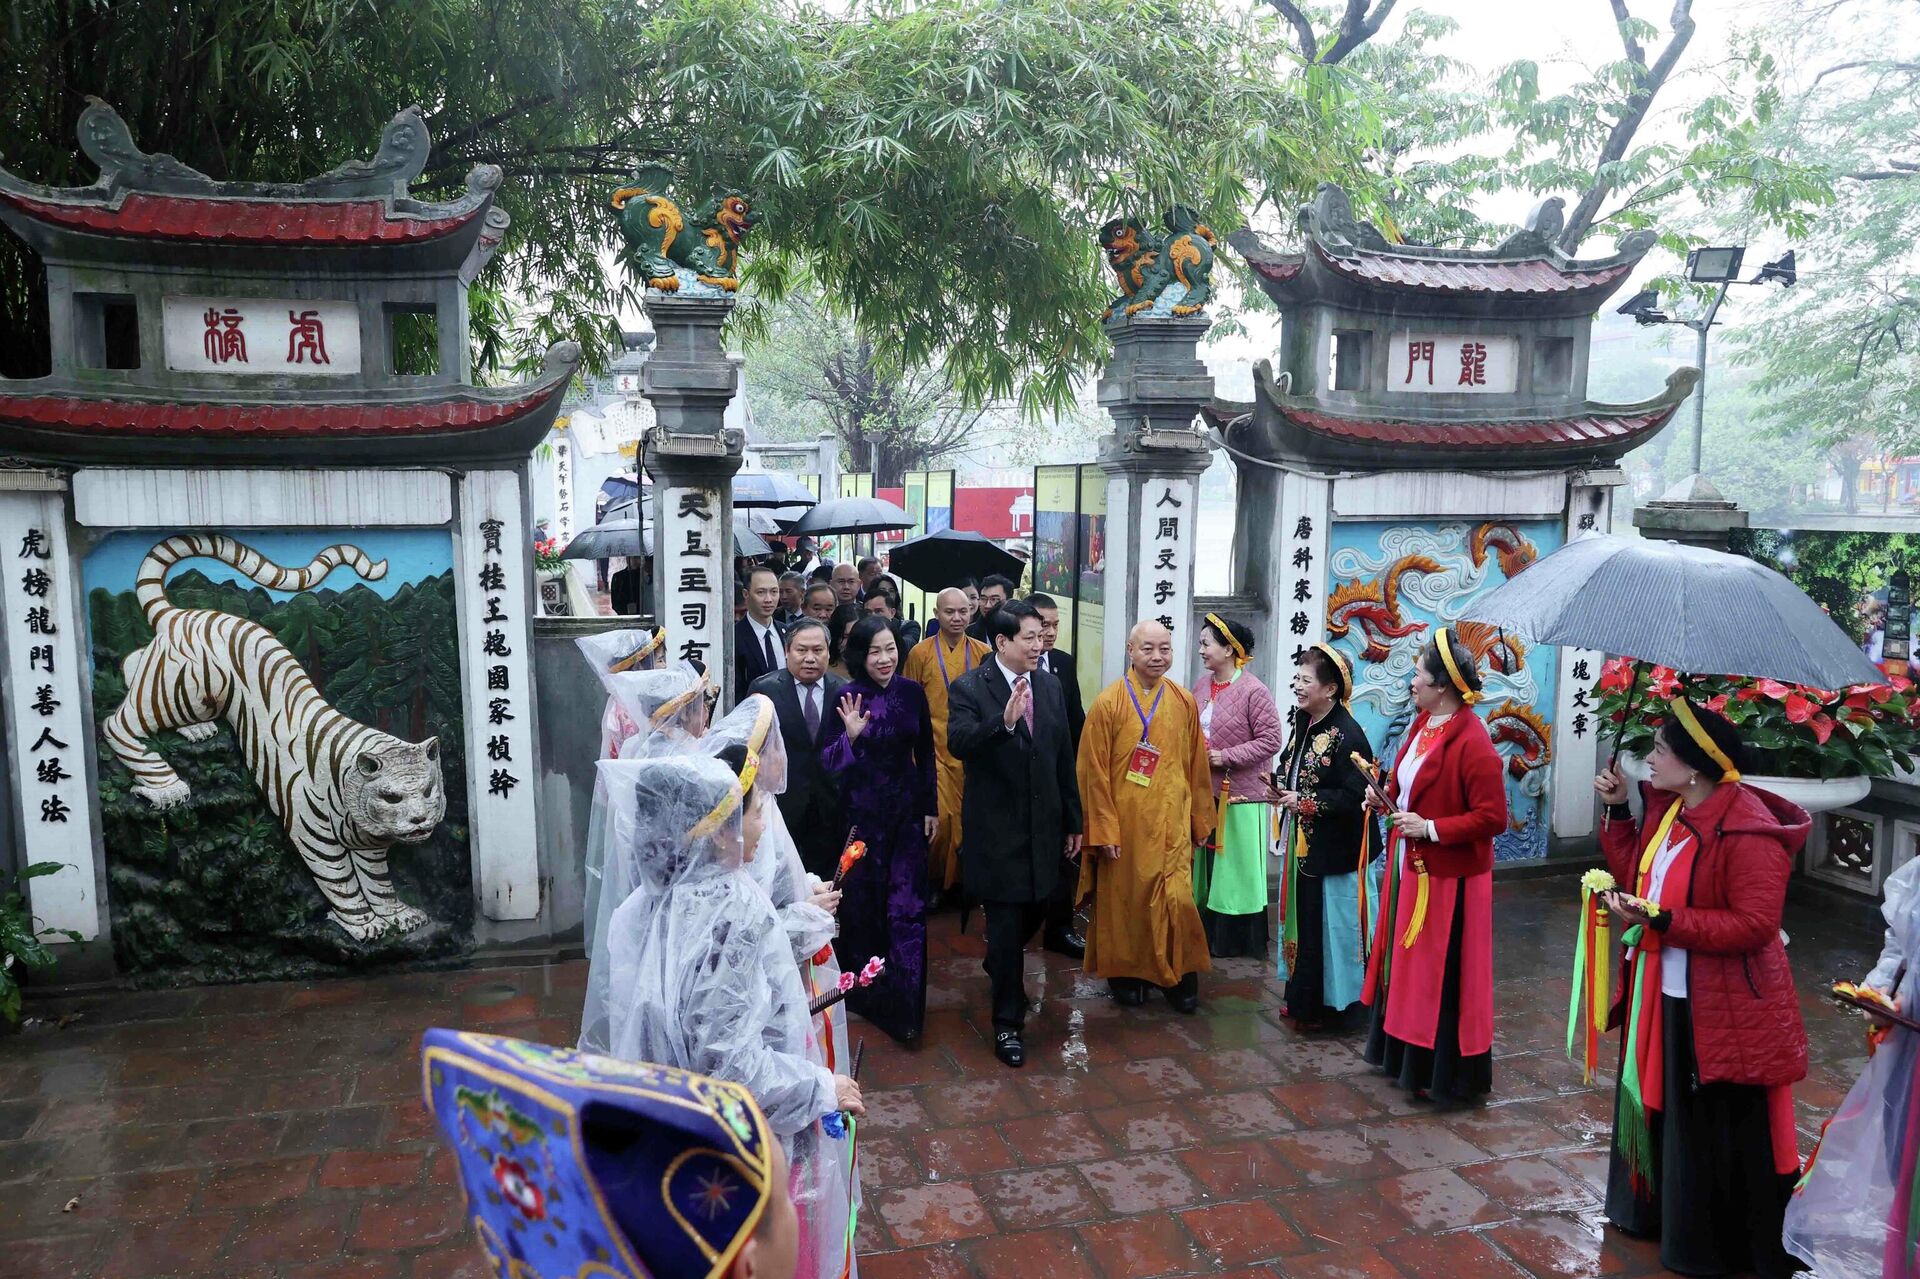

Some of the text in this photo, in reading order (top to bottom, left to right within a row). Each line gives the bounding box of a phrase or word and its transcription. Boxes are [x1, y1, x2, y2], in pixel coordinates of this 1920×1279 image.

[677, 494, 713, 661] 天上主司有
[1571, 647, 1591, 740] 塊文章
